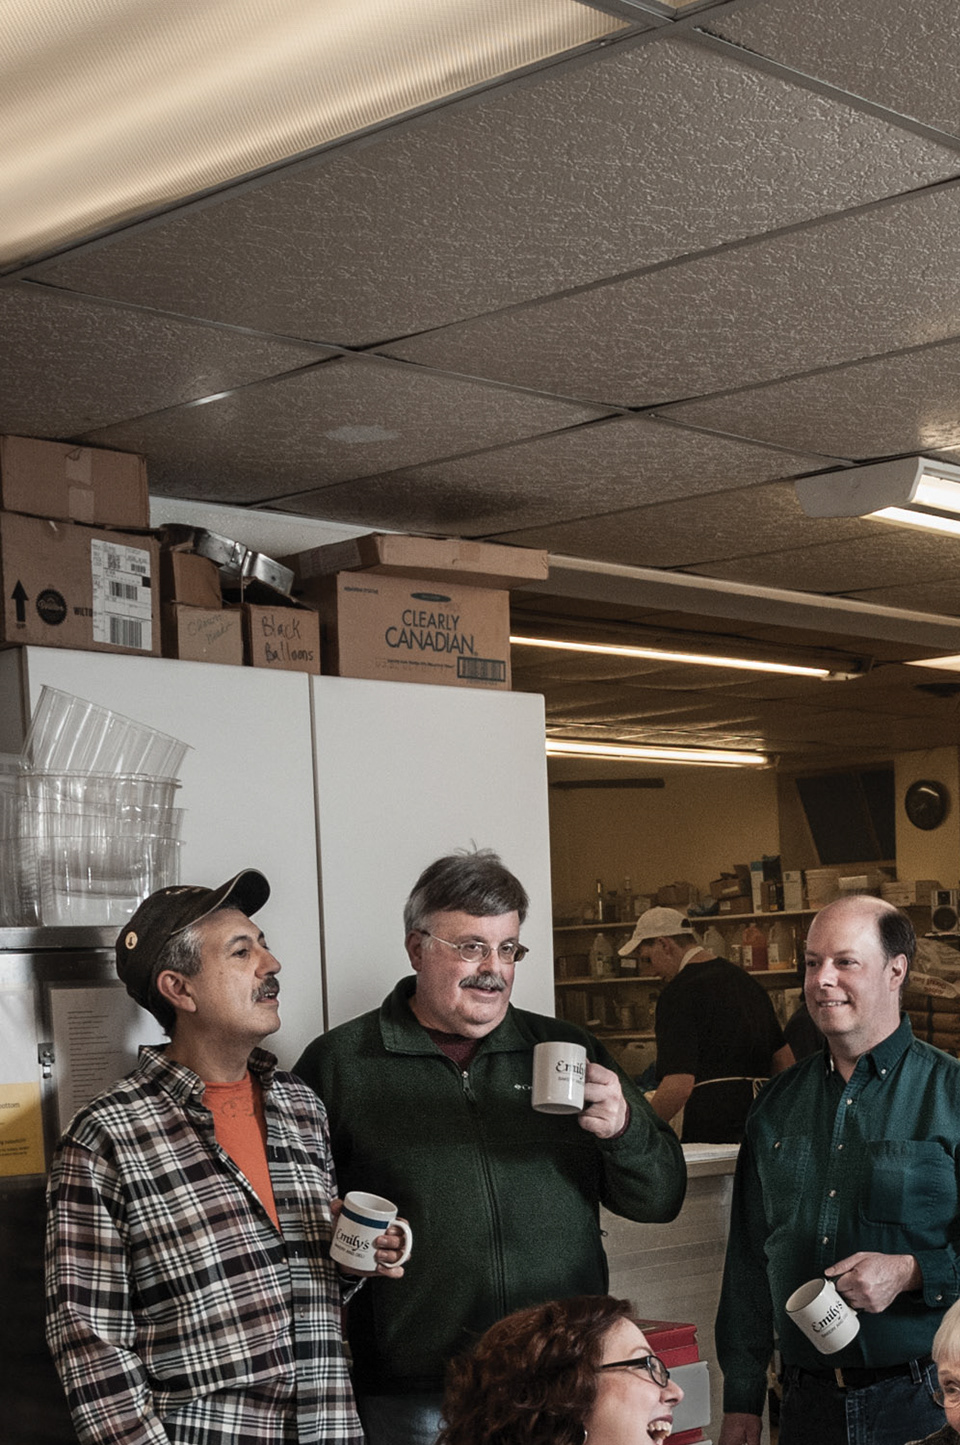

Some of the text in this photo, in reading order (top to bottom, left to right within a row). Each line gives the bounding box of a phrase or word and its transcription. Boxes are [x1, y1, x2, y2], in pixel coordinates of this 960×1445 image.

[262, 615, 302, 640] Black
[402, 609, 460, 632] CLEARLY
[265, 641, 314, 663] Balloons
[385, 626, 475, 655] CANADIAN
[336, 1228, 370, 1251] Emily's
[811, 1301, 842, 1333] Emily's
